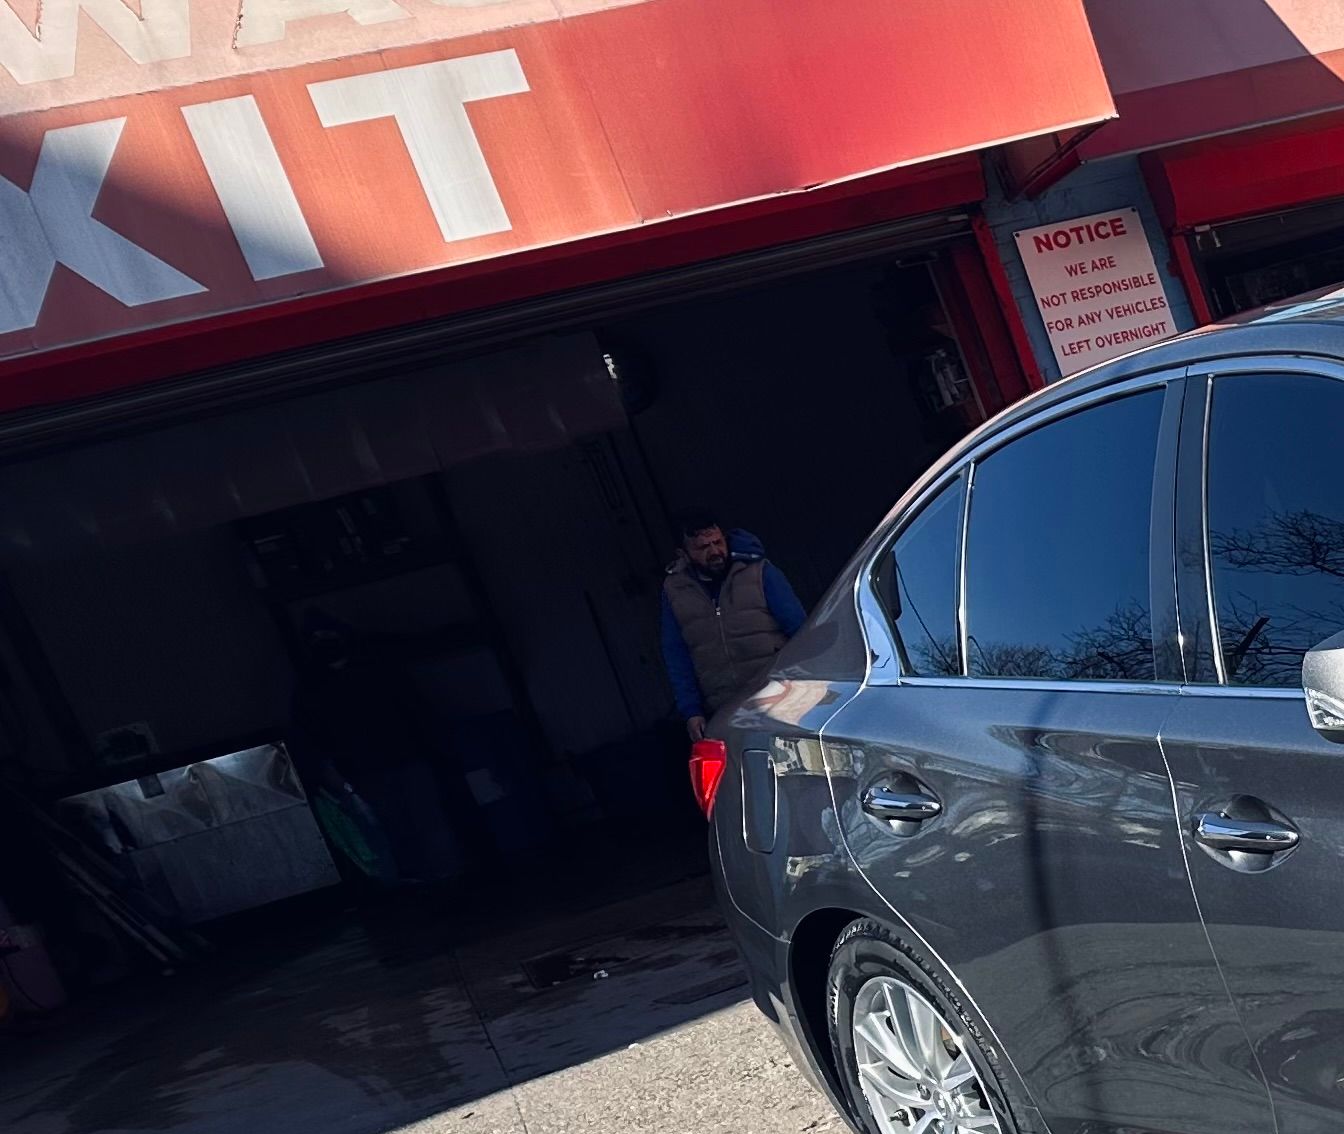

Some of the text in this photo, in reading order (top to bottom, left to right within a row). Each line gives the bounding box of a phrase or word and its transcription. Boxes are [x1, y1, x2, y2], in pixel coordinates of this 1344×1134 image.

[1033, 218, 1127, 253] NOTICE
[1064, 256, 1117, 277] WE ARE
[1040, 273, 1156, 309] NOT RESPONSIBLE
[1047, 296, 1167, 334] FOR ANY VEHICLES
[1061, 321, 1167, 357] LEFT OVERNIGHT
